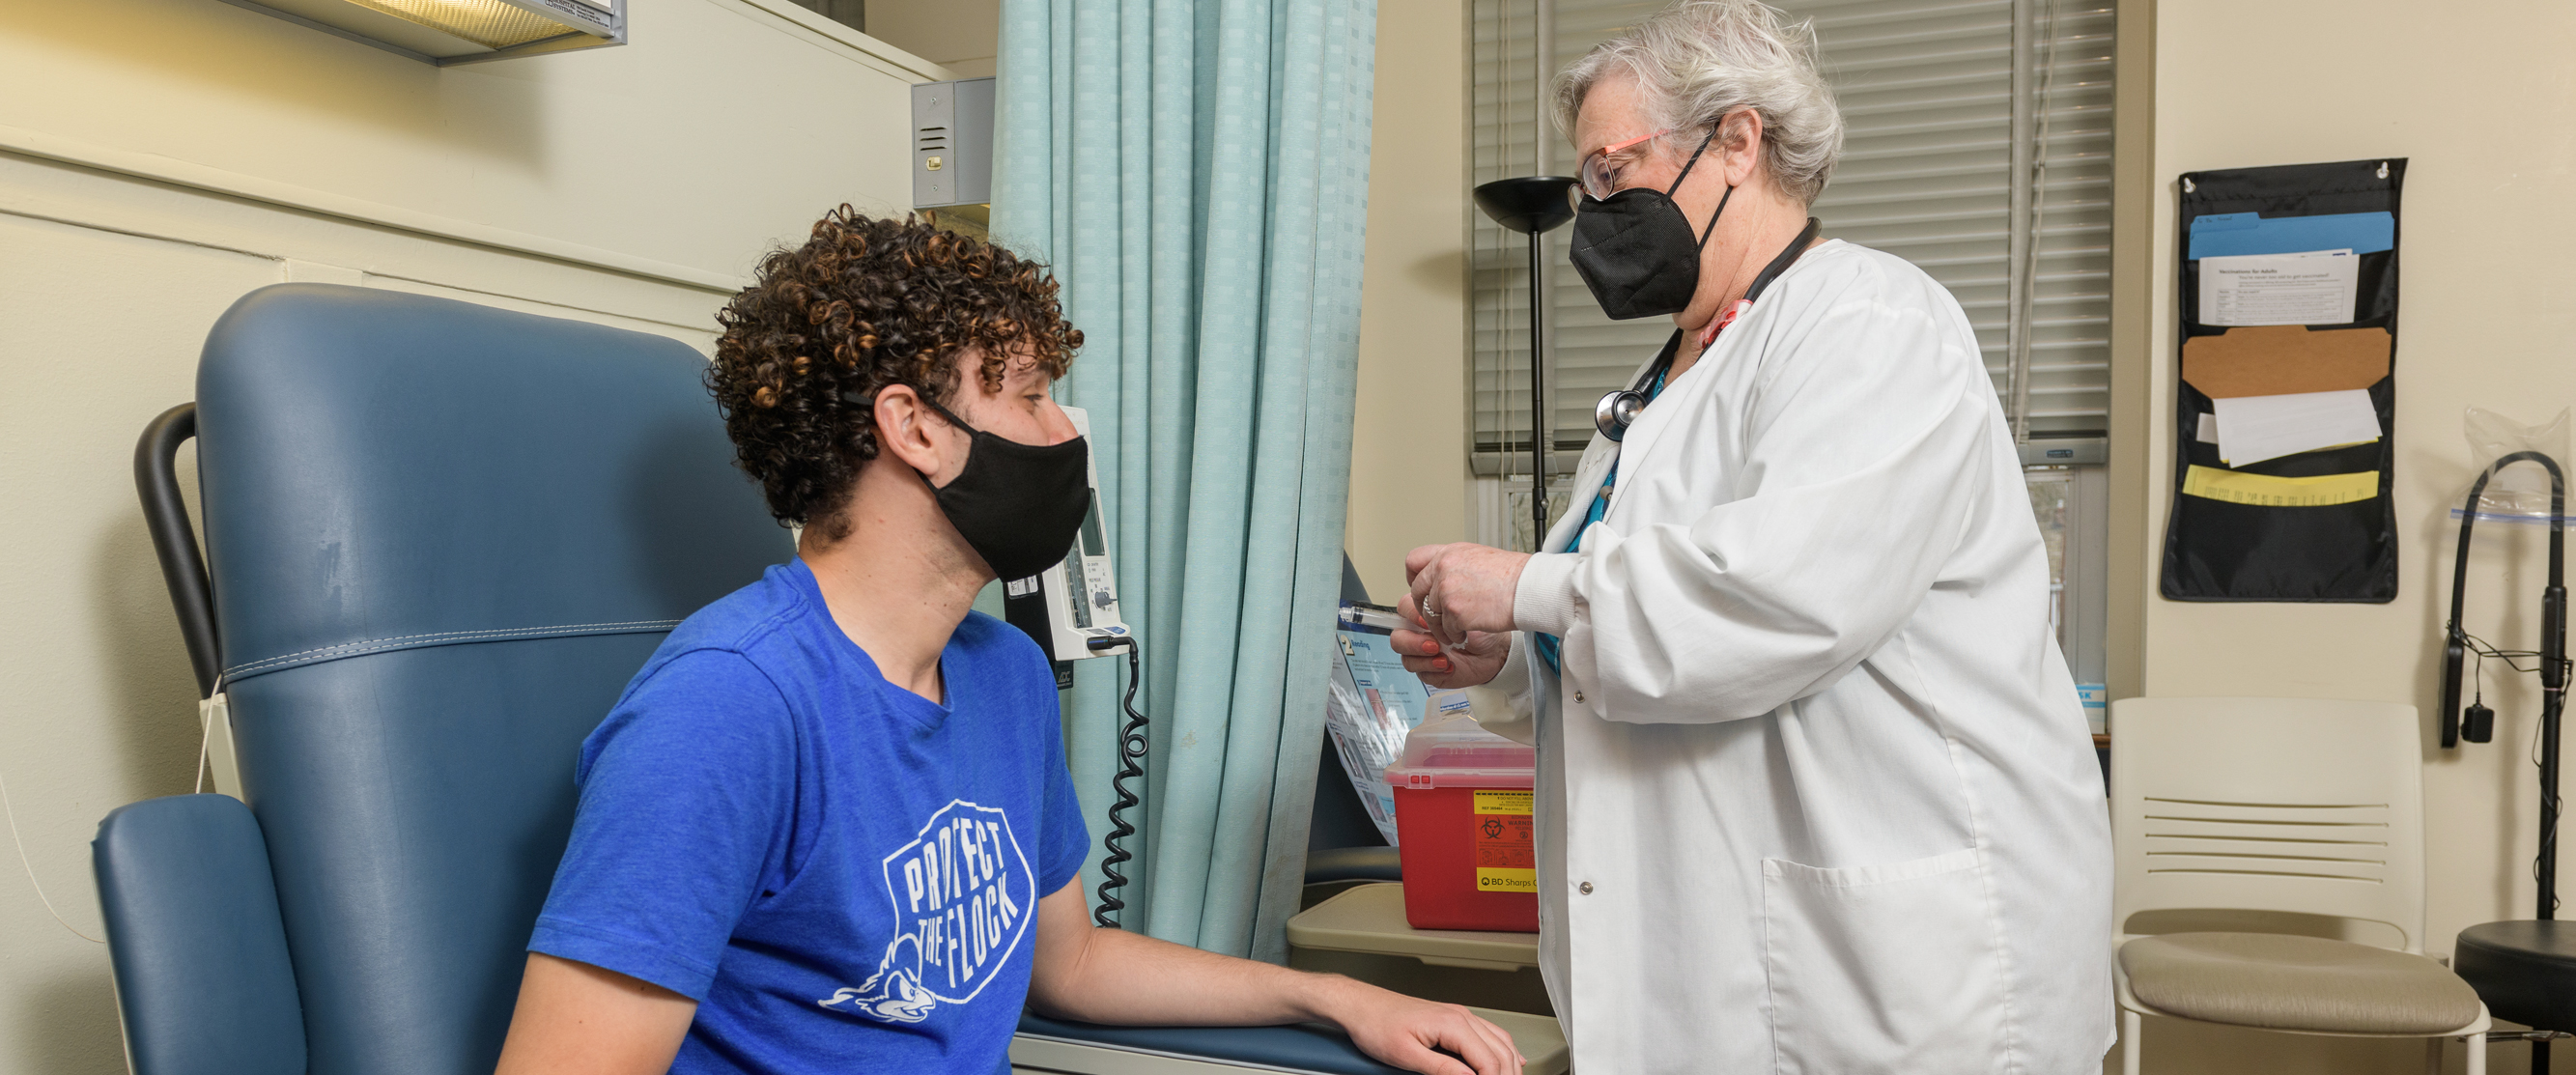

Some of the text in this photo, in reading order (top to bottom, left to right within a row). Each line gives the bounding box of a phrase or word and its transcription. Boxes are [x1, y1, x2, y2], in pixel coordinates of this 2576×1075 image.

[1340, 635, 1355, 656] 2
[904, 817, 1005, 914] PROTECT
[1505, 878, 1532, 888] Sharps
[918, 871, 1019, 989] THE FLOCK
